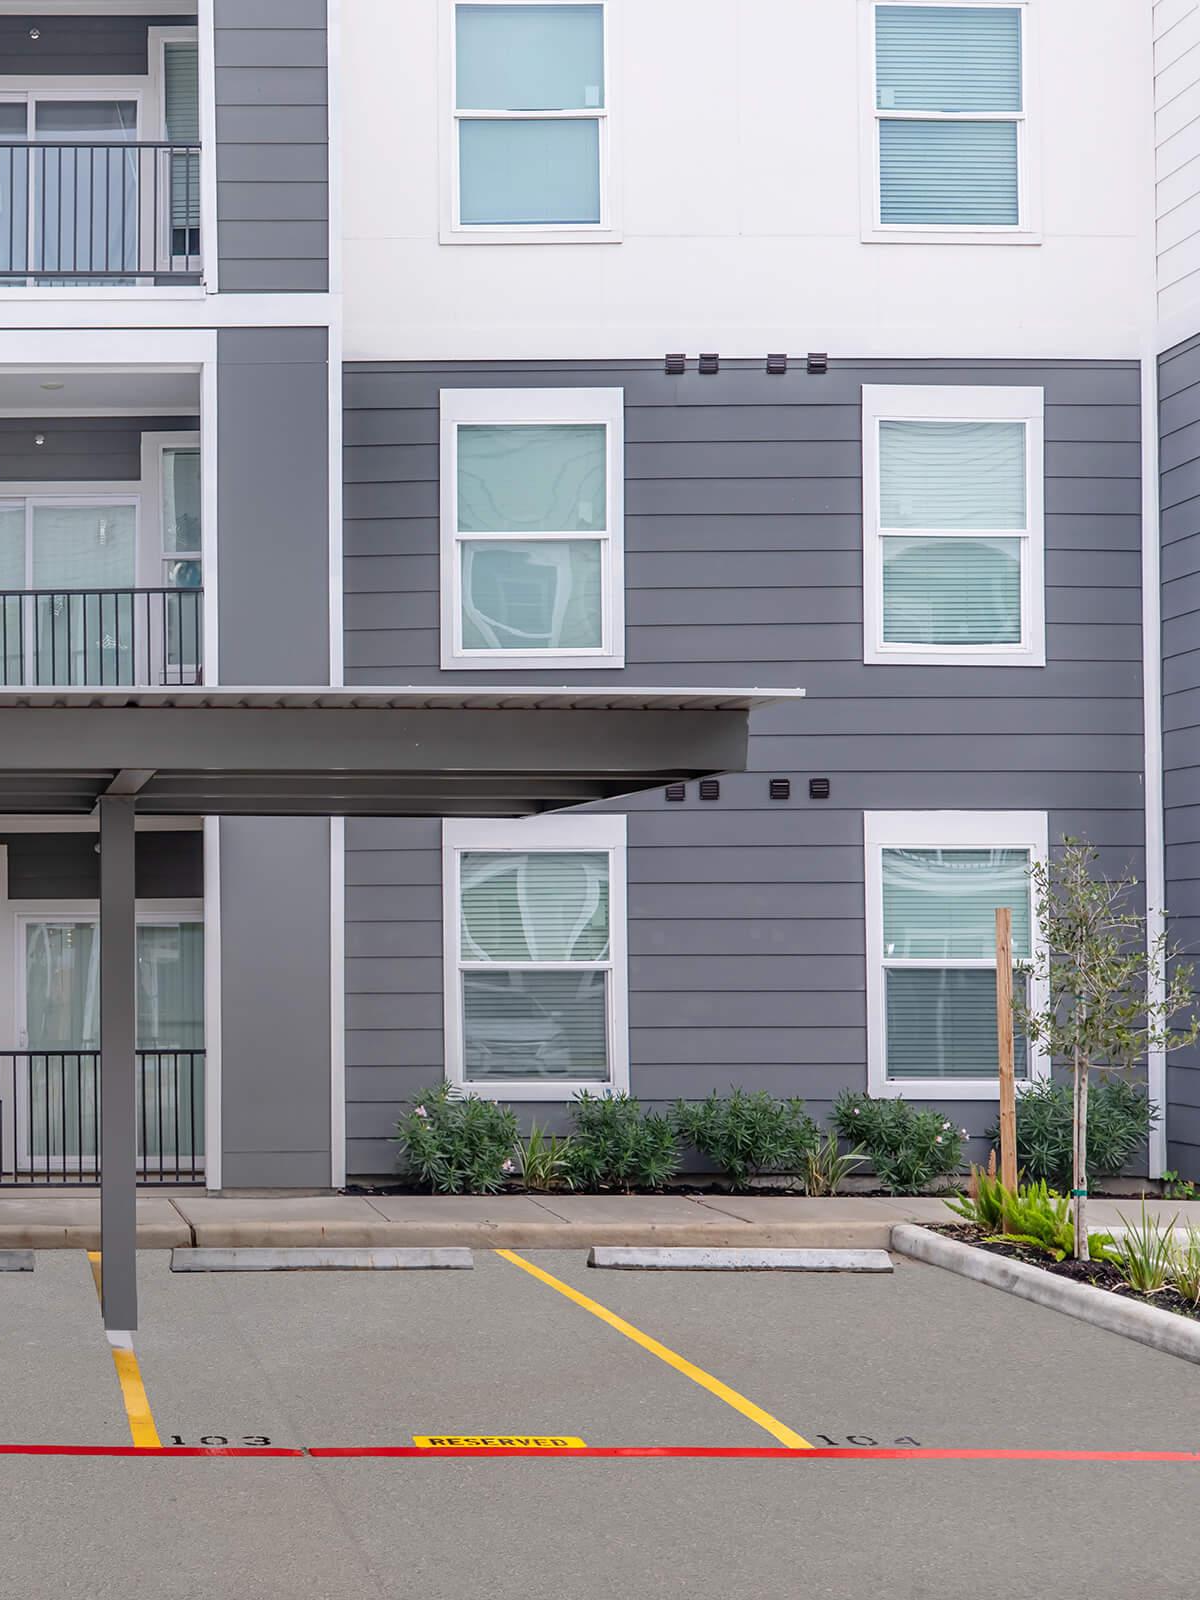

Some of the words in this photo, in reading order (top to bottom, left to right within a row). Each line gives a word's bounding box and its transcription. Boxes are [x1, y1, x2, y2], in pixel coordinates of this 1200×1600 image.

[171, 1435, 272, 1446] 103
[428, 1437, 568, 1447] RESERVED
[816, 1434, 921, 1446] 104
